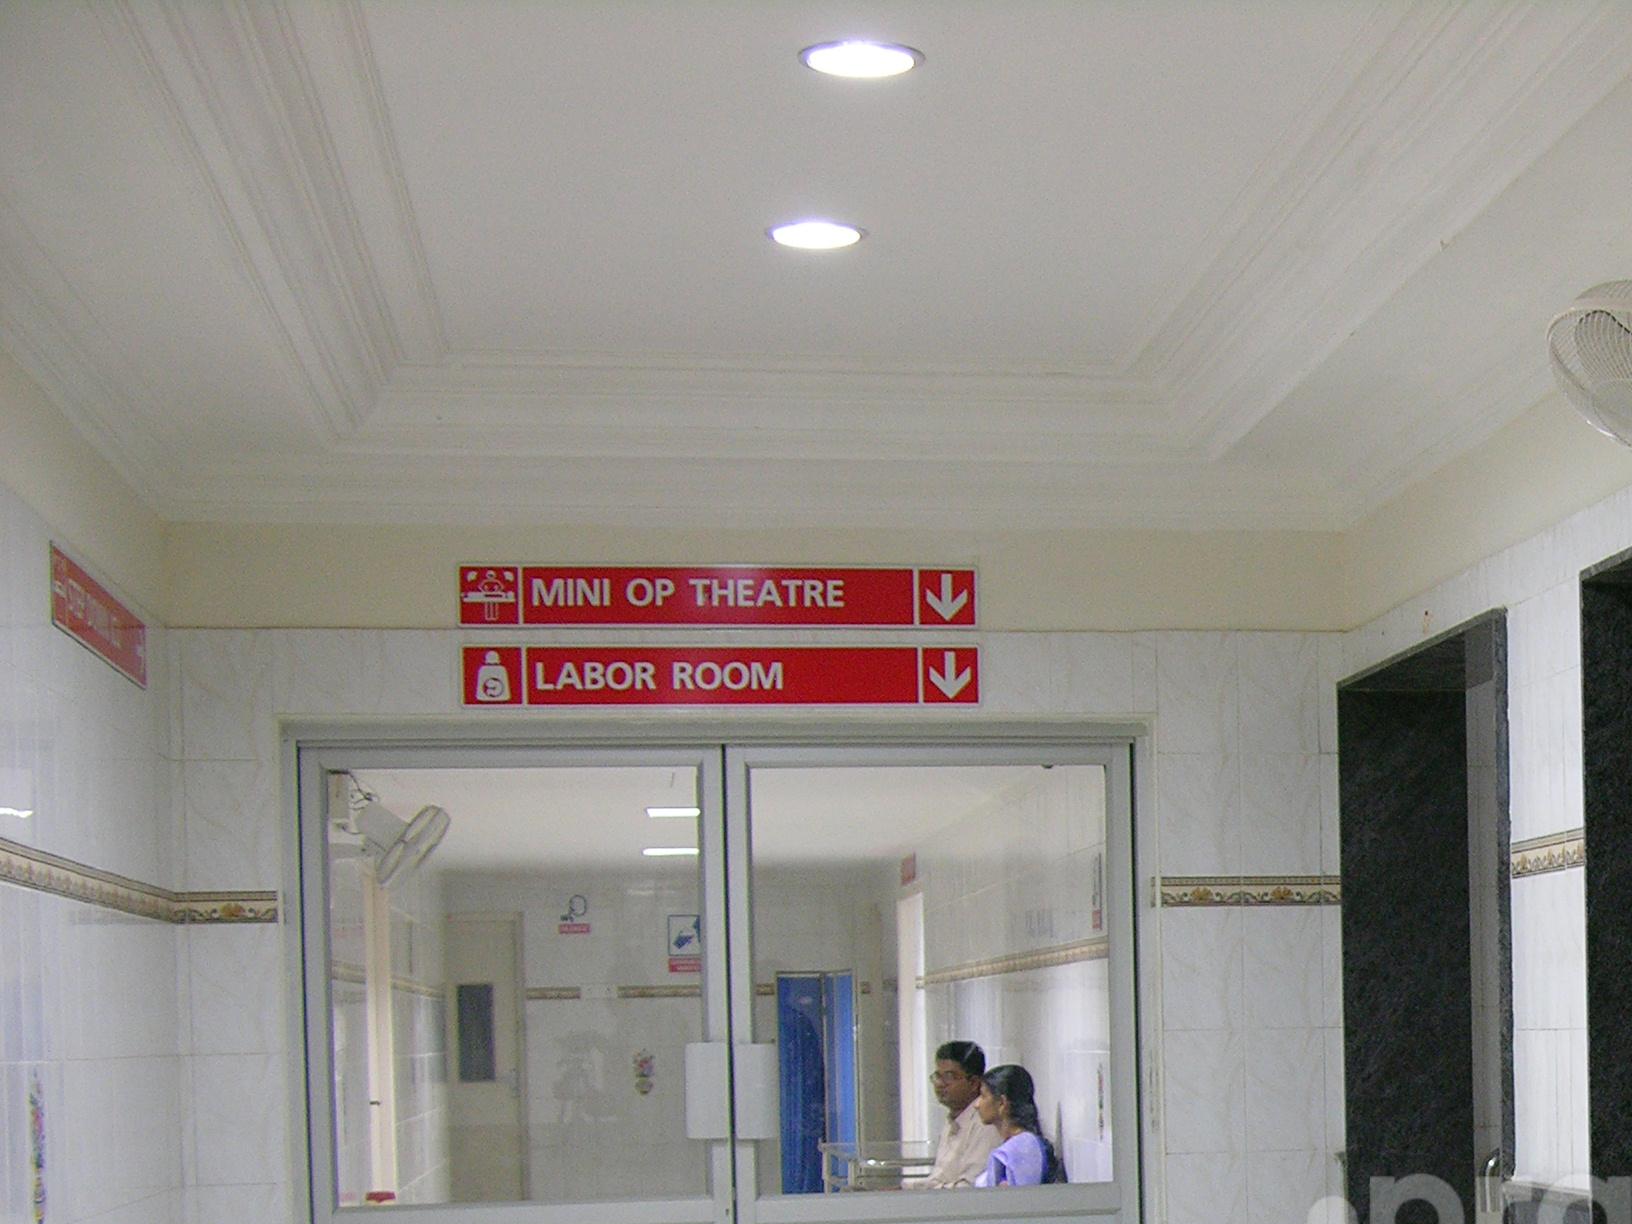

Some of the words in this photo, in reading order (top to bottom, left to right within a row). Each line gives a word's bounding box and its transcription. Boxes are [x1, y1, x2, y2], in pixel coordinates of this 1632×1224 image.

[531, 577, 611, 607] MINI
[625, 577, 676, 608] OP
[687, 577, 846, 608] THEATRE
[535, 661, 658, 691] LABOR
[672, 660, 784, 691] ROOM
